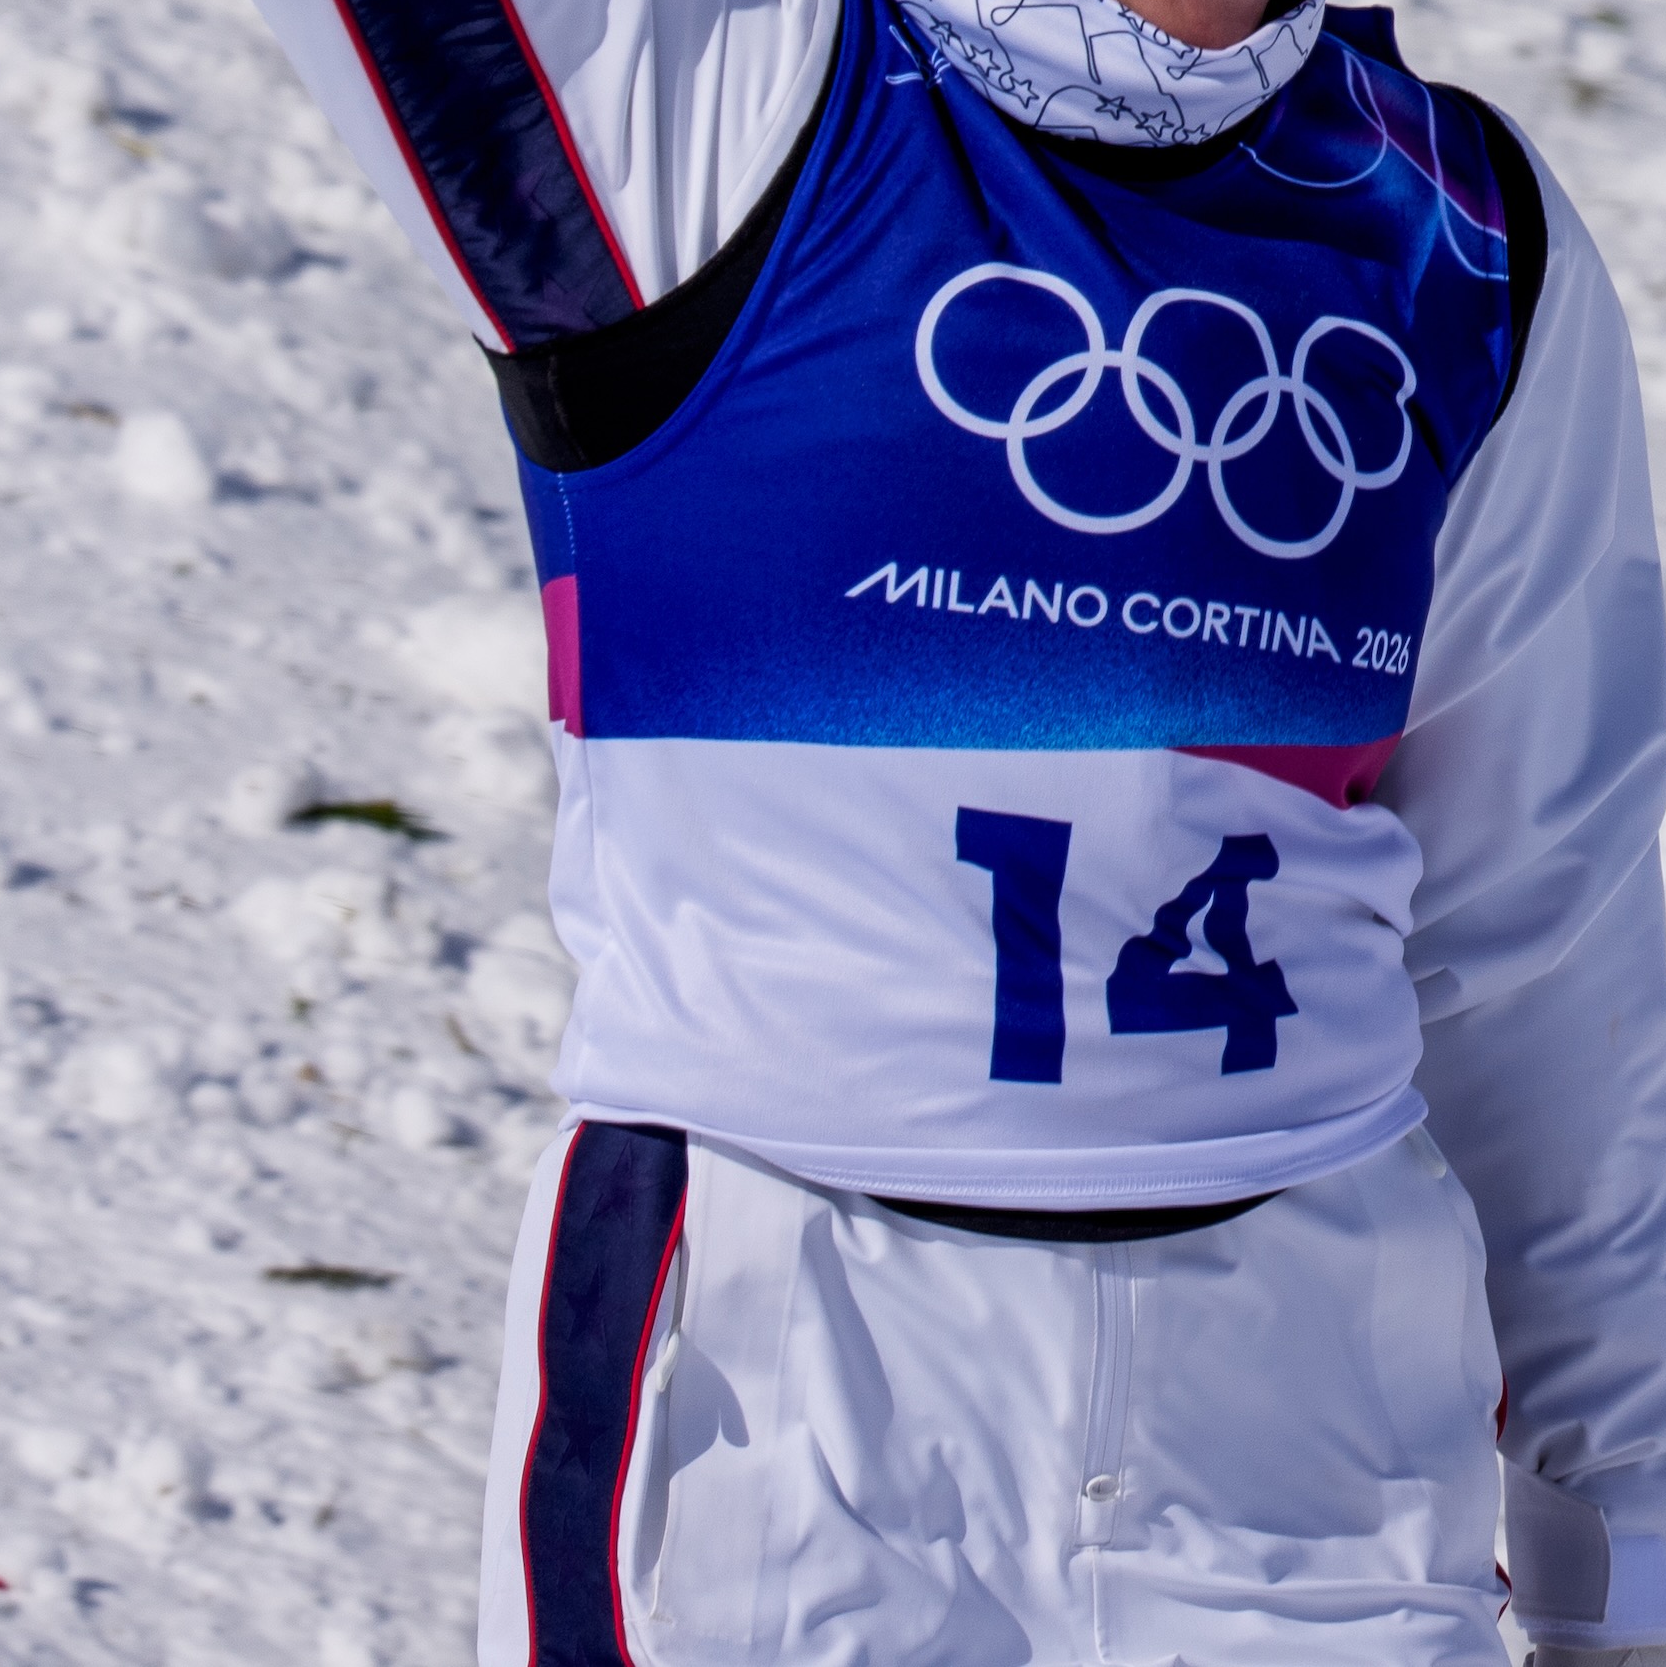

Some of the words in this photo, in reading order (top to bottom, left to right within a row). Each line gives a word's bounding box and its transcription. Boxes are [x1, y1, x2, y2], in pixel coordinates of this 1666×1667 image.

[844, 562, 1108, 627] MILANO
[1121, 592, 1341, 664] CORTINA
[1351, 627, 1412, 675] 2026
[954, 805, 1300, 1085] 14
